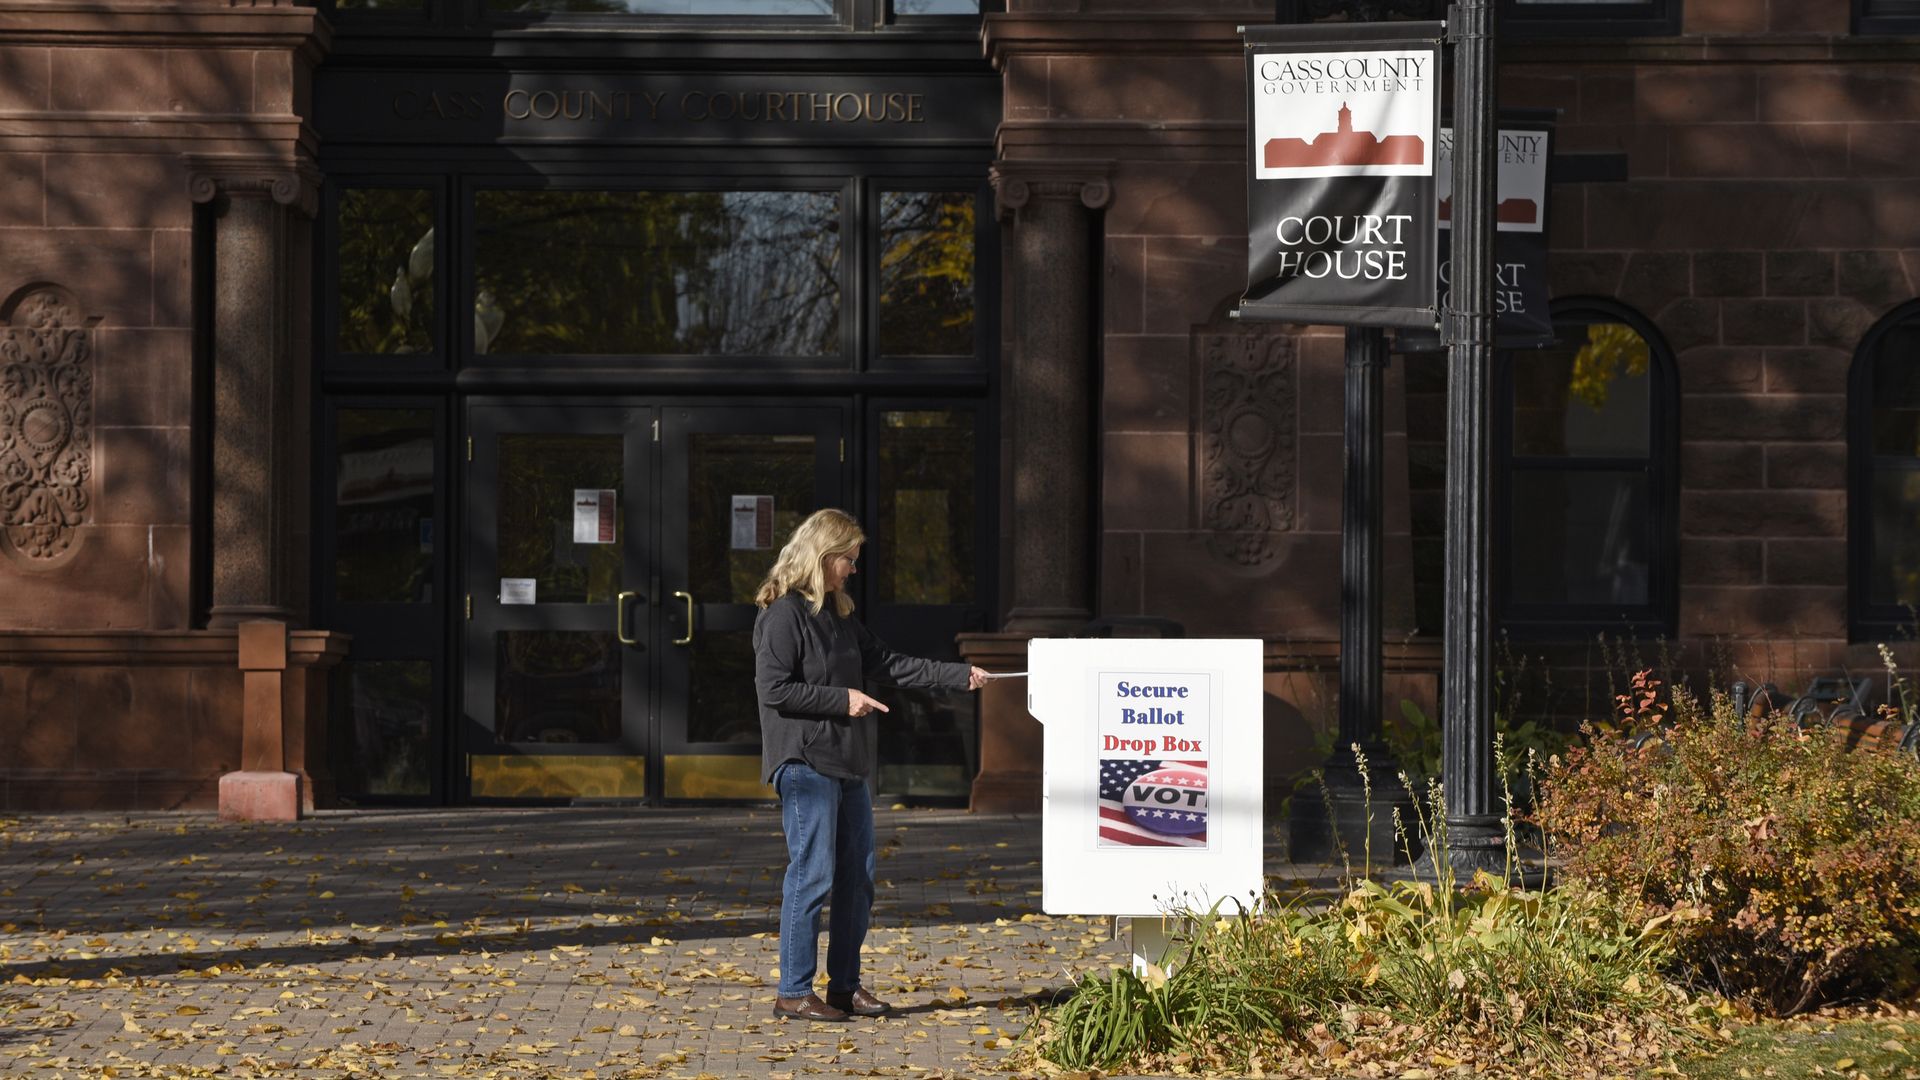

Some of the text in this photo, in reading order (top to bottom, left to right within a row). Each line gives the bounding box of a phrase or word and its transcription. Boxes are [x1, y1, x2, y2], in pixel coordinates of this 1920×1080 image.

[1261, 57, 1426, 82] CASS COUNTY
[1263, 79, 1424, 96] GOVERNMENT
[392, 88, 925, 123] CASS COUNTY COURTHOUSE
[1498, 134, 1542, 153] UNTY
[1276, 215, 1412, 246] COURT
[1277, 250, 1408, 280] HOUSE
[1117, 681, 1189, 698] Secure
[1121, 708, 1185, 725] Ballot
[1103, 735, 1202, 755] Drop Box
[1132, 785, 1207, 808] VOT
